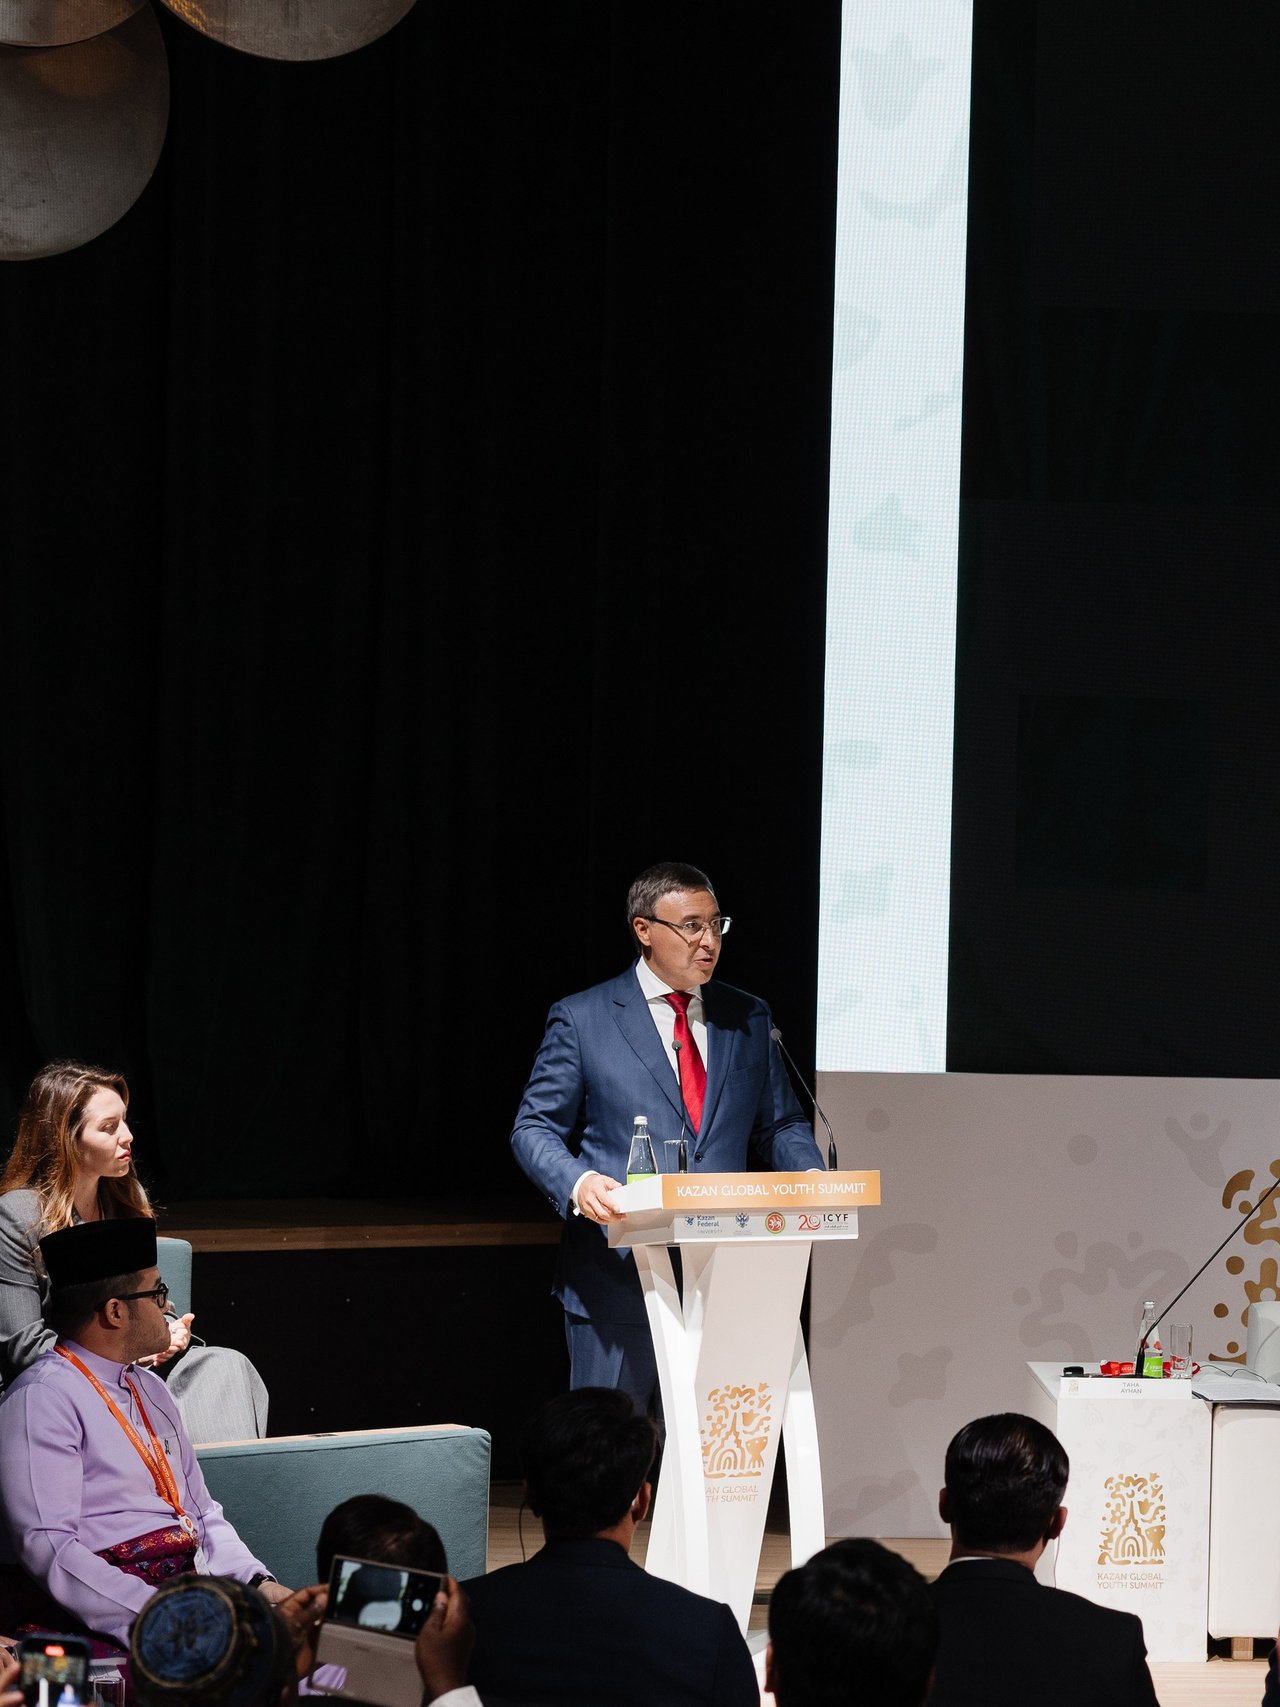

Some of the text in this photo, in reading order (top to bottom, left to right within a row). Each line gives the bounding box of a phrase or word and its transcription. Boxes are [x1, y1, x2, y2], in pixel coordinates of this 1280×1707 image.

[676, 1182, 867, 1197] KAZAN GLOBAL YOUTH SUMMIT
[823, 1213, 849, 1222] ICYF
[721, 1485, 759, 1494] GLOBAL
[705, 1493, 758, 1503] TH SUMMIT
[1097, 1572, 1164, 1581] KAZAN GLOBAL
[1097, 1581, 1164, 1590] YOUTH SUMMIT
